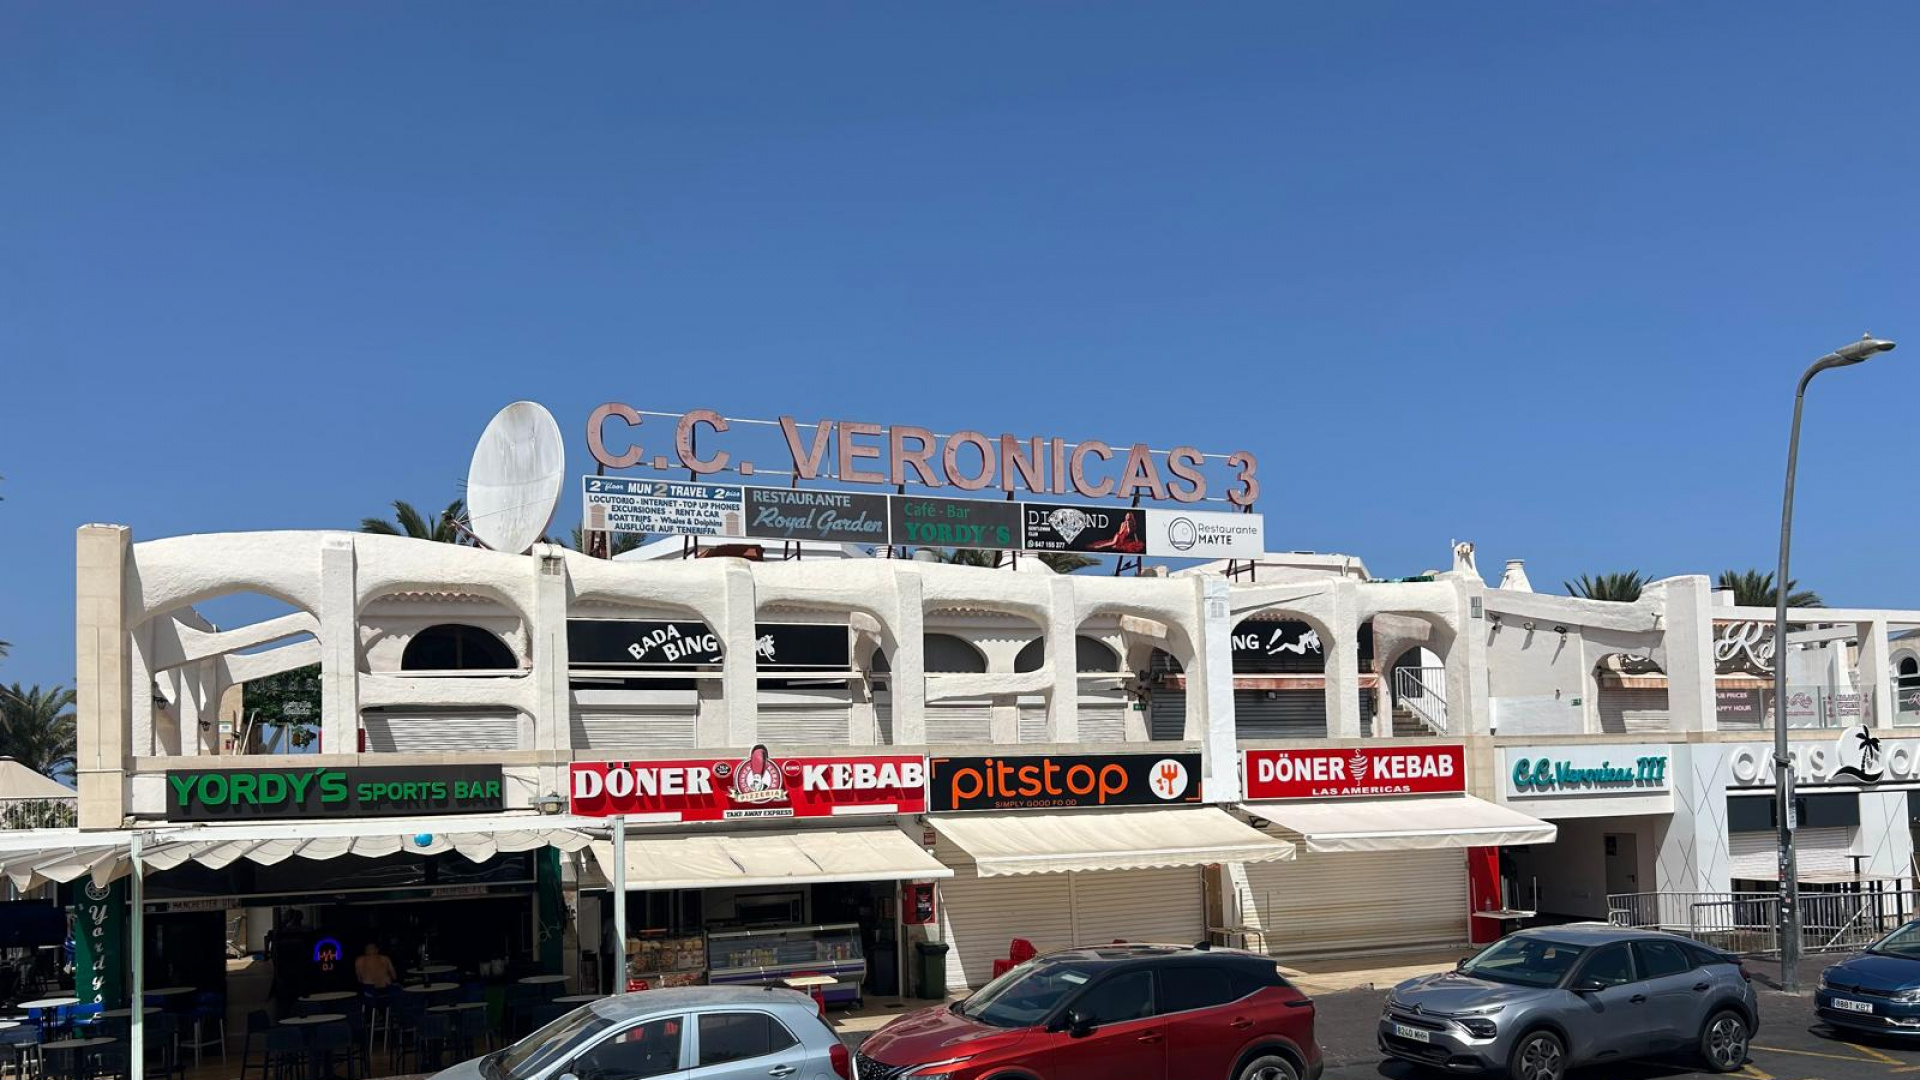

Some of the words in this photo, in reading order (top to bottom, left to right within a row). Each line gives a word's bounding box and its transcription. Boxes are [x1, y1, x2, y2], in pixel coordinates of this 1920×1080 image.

[586, 402, 754, 475] C.C.
[778, 415, 1208, 503] VERONICAS
[1228, 450, 1260, 506] 3
[628, 482, 652, 495] MUN
[653, 483, 668, 497] 2
[670, 485, 708, 498] TRAVEL
[589, 494, 635, 505] LOCUTORIO
[640, 498, 678, 508] INTERNET
[683, 501, 698, 509] TOP
[699, 501, 710, 510] UP
[710, 502, 740, 511] PHONES
[753, 490, 852, 508] RESTAURANTE
[611, 505, 666, 515] EXCURSIONES
[675, 508, 694, 517] RENT
[704, 510, 719, 518] CAR
[904, 501, 936, 517] Café
[947, 504, 971, 518] Bar
[608, 513, 630, 522] BOAT
[630, 514, 652, 523] TRIPS
[660, 517, 685, 525] Whales
[687, 518, 692, 526] &
[694, 518, 722, 527] Dolphins
[614, 521, 655, 532] AUSFLÜGE
[659, 524, 674, 533] AUF
[677, 525, 717, 535] TENERIFFA
[751, 506, 817, 537] Royal
[817, 510, 883, 537] Garden
[1028, 510, 1110, 529] DIND
[904, 521, 1011, 545] YORDY'S
[1198, 522, 1258, 535] Restaurante
[1198, 534, 1232, 545] MAYTE
[628, 623, 681, 660] BADA
[662, 634, 718, 662] BING
[1231, 634, 1260, 651] NG
[1726, 691, 1748, 699] PRICES
[1733, 704, 1752, 712] HOUR
[1258, 753, 1346, 782] DÖNER
[1373, 754, 1454, 780] KEBAB
[1555, 760, 1635, 785] Veronicas
[1635, 756, 1668, 780] III
[167, 767, 349, 807] YORDY'S
[357, 781, 447, 802] SPORTS
[454, 780, 500, 799] BAR
[573, 762, 714, 799] DÖNER
[803, 761, 925, 792] KEBAB
[952, 758, 1129, 810] pitstop
[741, 790, 780, 800] PIZZERIA
[1312, 786, 1338, 796] LAS
[1341, 785, 1411, 795] AMERICAS
[994, 801, 1024, 809] SIMPLY
